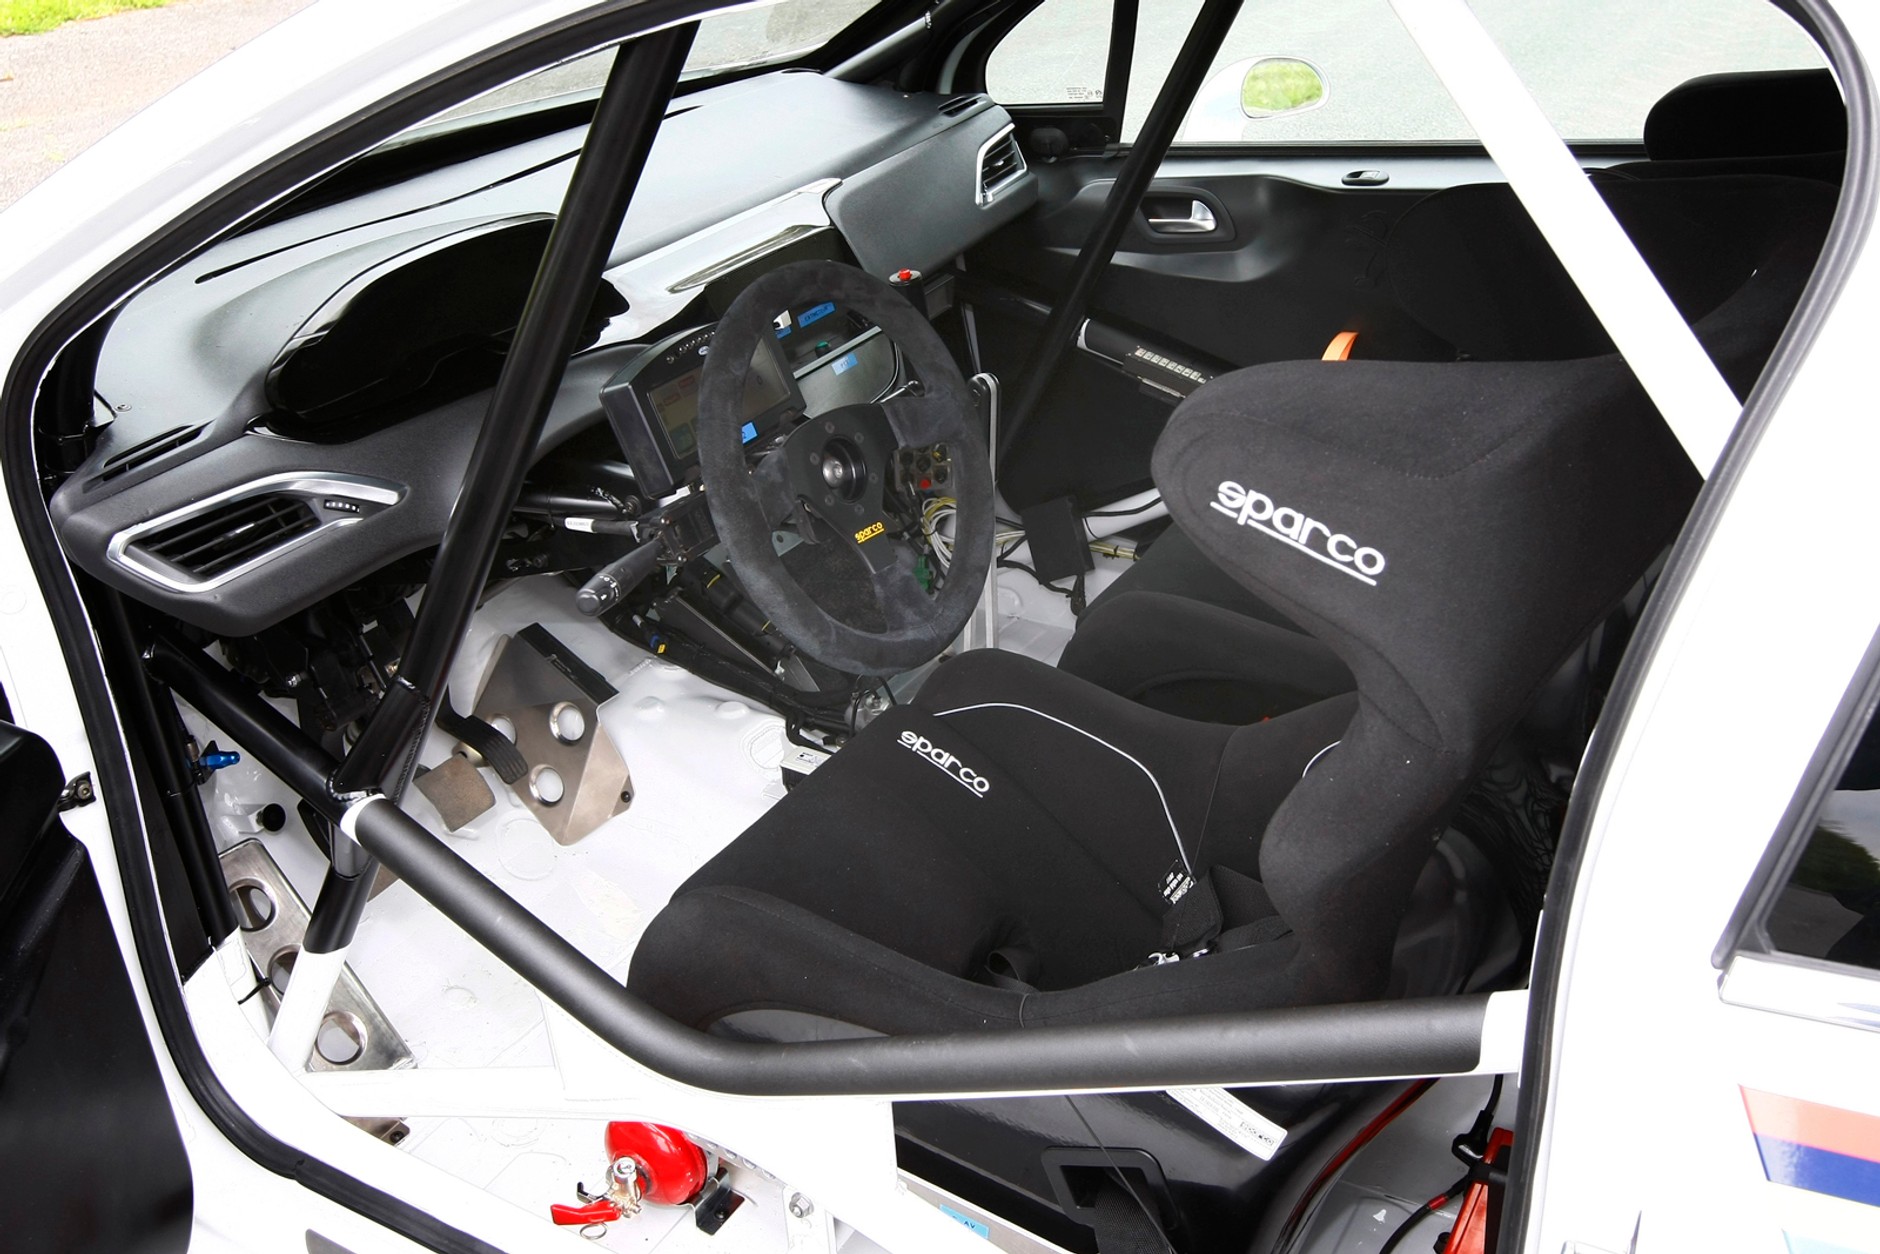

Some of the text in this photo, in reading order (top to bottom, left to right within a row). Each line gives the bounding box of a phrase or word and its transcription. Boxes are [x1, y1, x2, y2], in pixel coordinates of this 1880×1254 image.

[855, 521, 883, 542] sparco
[1217, 480, 1386, 576] sparco
[900, 730, 990, 793] sparco
